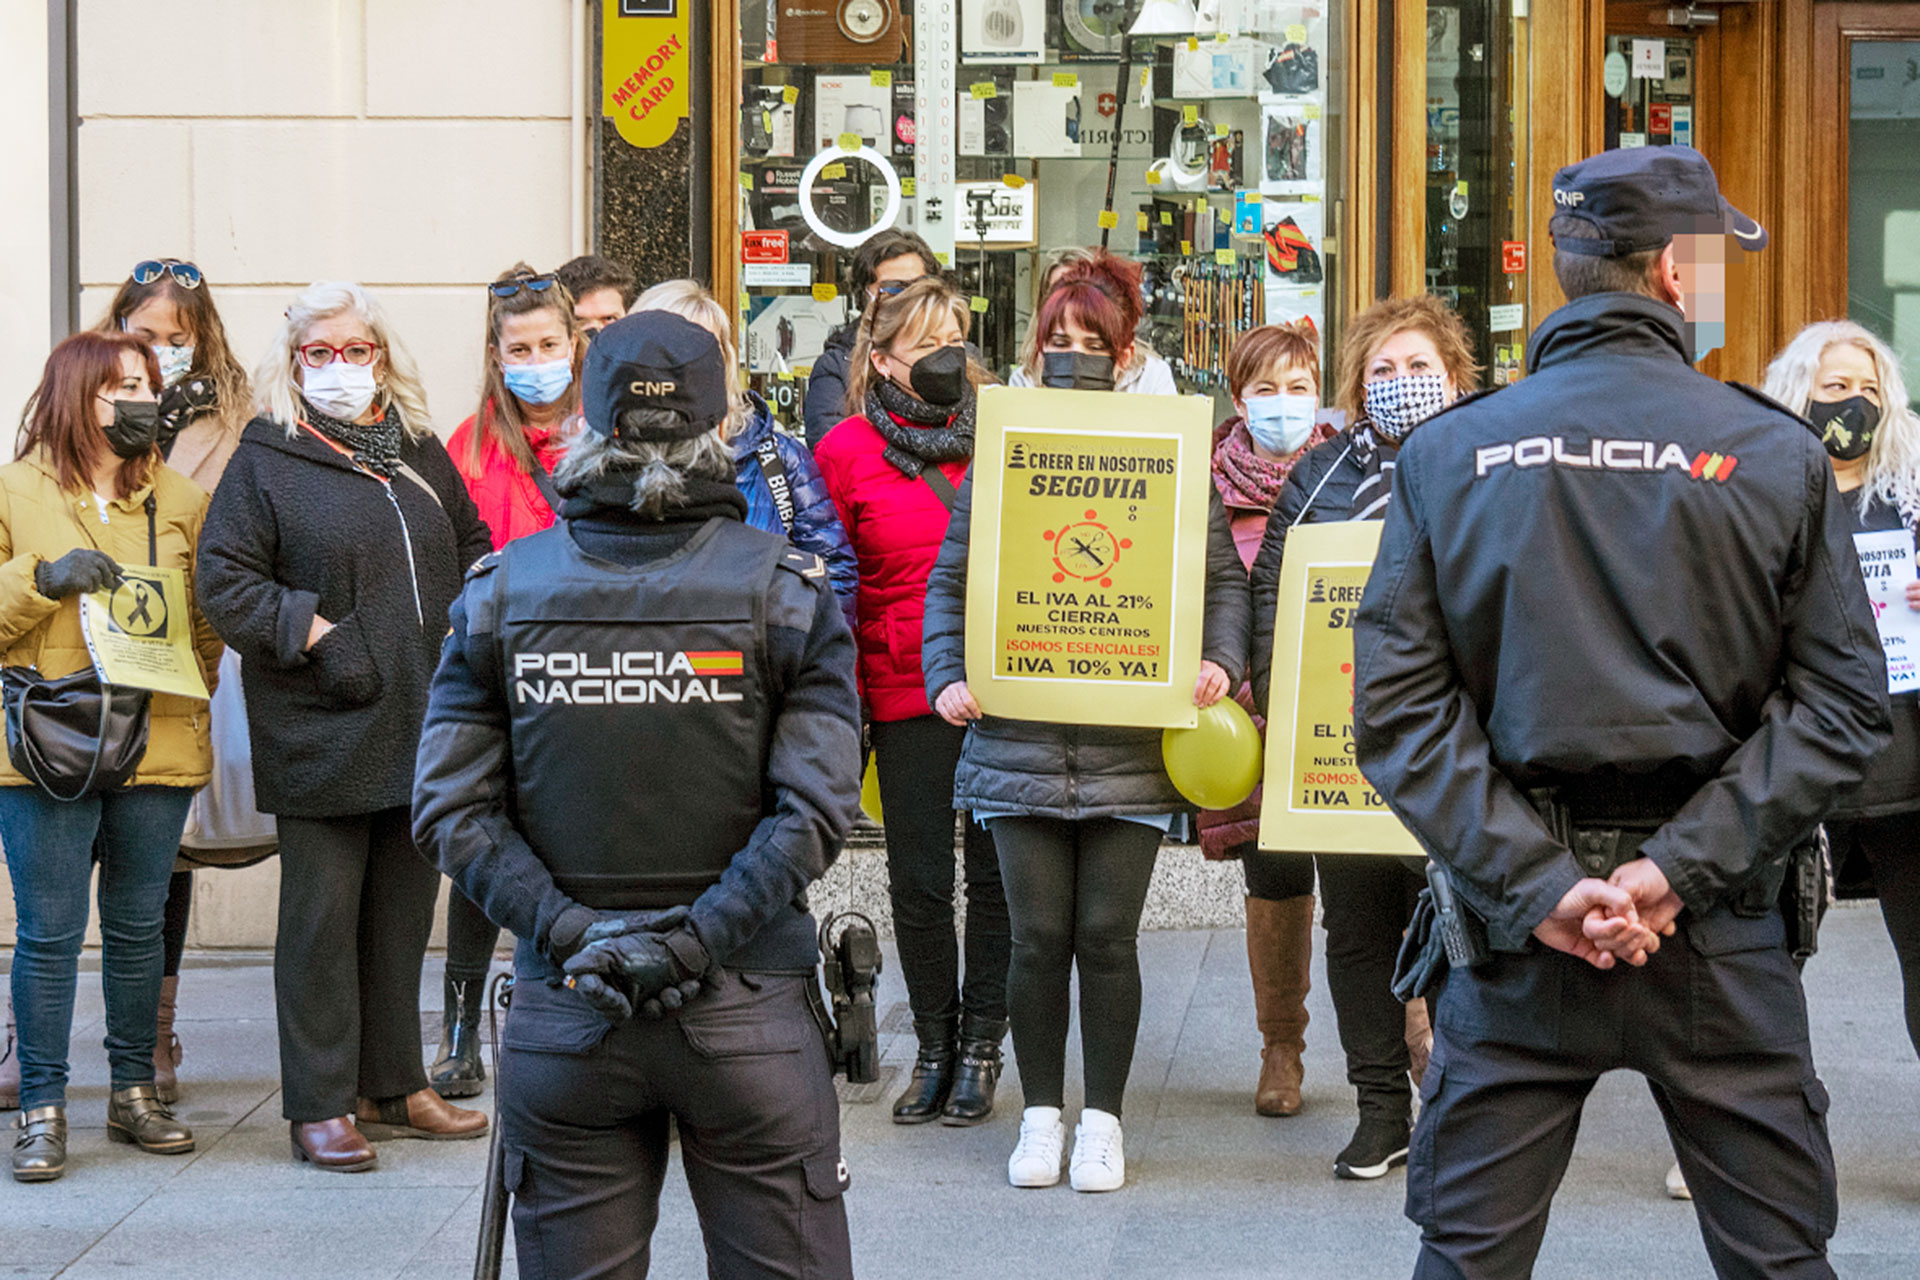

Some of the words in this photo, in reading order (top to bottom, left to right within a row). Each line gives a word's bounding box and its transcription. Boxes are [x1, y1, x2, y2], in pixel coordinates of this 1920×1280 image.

[611, 34, 682, 108] MEMORY
[630, 76, 674, 120] CARD
[1554, 188, 1584, 206] CNP
[630, 382, 676, 396] CNP
[1030, 453, 1073, 470] CREER
[1078, 455, 1094, 471] EN
[1100, 456, 1174, 474] NOSOTROS
[1476, 436, 1691, 476] POLICIA
[1029, 474, 1147, 500] SEGOVIA
[1016, 591, 1040, 604] EL
[1046, 593, 1078, 606] IVA
[1084, 594, 1110, 608] AL
[1117, 595, 1153, 610] 21%
[1329, 586, 1365, 602] CREE
[1048, 610, 1120, 624] CIERRA
[1016, 624, 1086, 636] NUESTROS
[1090, 626, 1150, 638] CENTROS
[1006, 640, 1062, 652] ¡SOMOS
[1066, 642, 1160, 656] ESENCIALES!
[514, 651, 696, 677] POLICIA
[1068, 660, 1111, 676] 10%
[1118, 662, 1158, 678] YA!
[516, 678, 744, 704] NACIONAL
[1314, 724, 1336, 738] EL
[1304, 772, 1358, 785] ¡SOMOS
